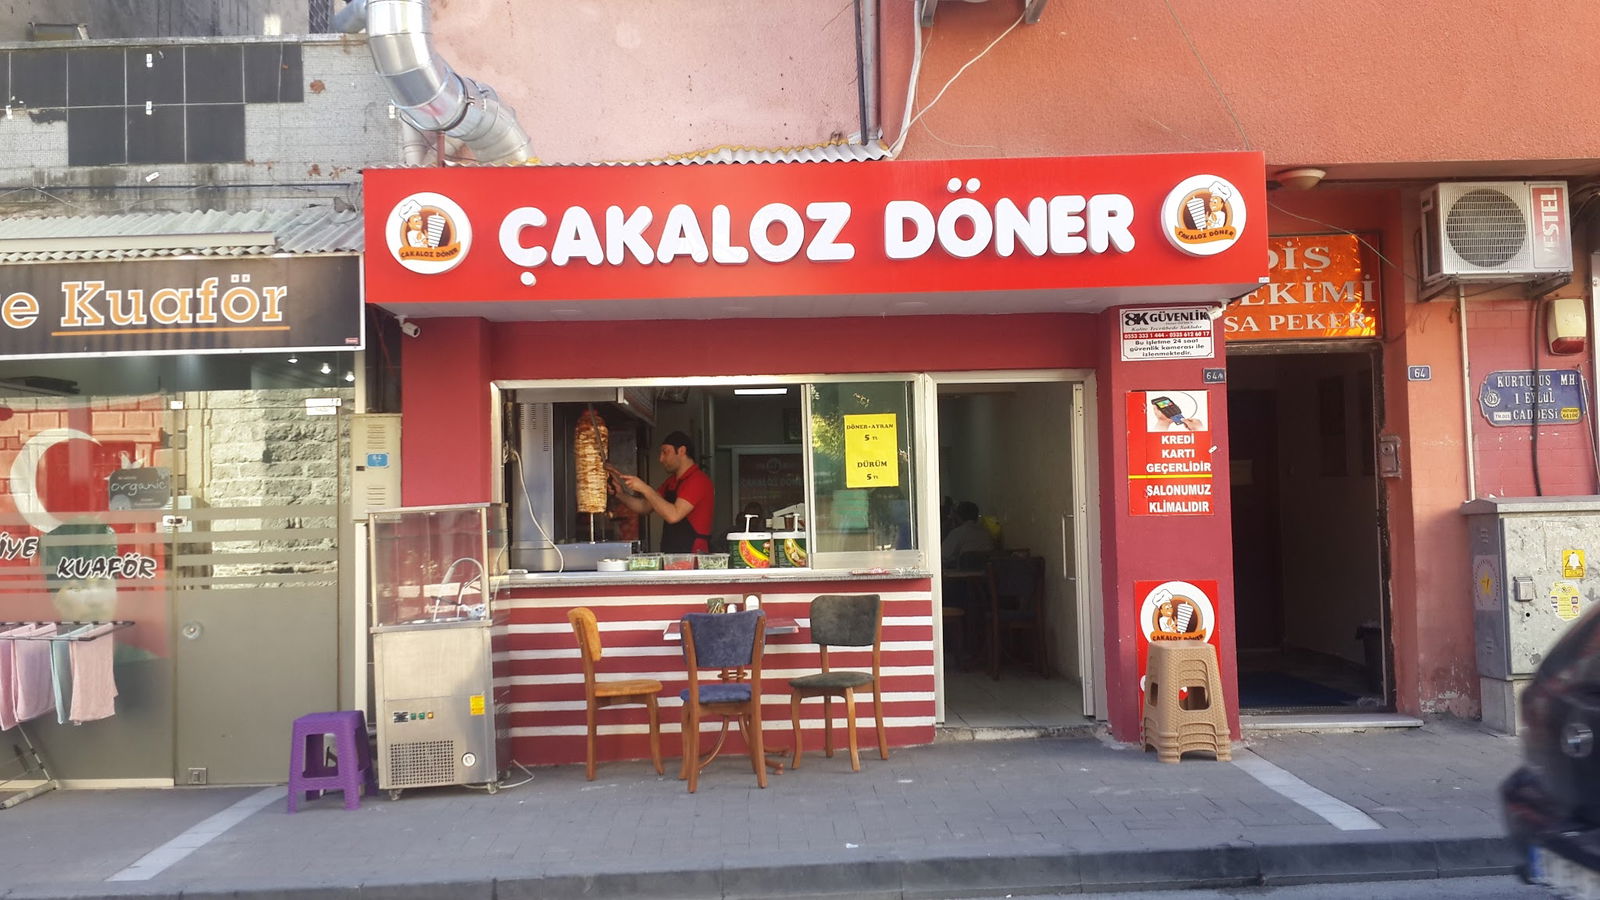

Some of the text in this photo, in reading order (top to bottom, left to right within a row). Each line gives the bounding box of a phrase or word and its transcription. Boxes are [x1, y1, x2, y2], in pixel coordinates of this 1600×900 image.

[498, 177, 1136, 287] ÇAKALOZ DÖNER
[1230, 275, 1376, 306] EKİMİ
[0, 274, 288, 329] e Kuaför
[1149, 309, 1210, 322] GÜVENLİK
[1269, 312, 1367, 331] PEKER
[1413, 368, 1426, 378] 64
[1161, 433, 1194, 444] KREDİ
[1161, 449, 1194, 458] KARTI
[857, 460, 888, 468] DÜRÜM
[1146, 461, 1211, 474] GEÇERLİDİR
[110, 479, 168, 497] organic
[1146, 484, 1212, 496] SALONUMUZ
[1149, 500, 1209, 512] KLİMALIDIR
[56, 552, 157, 579] KUAFÖR
